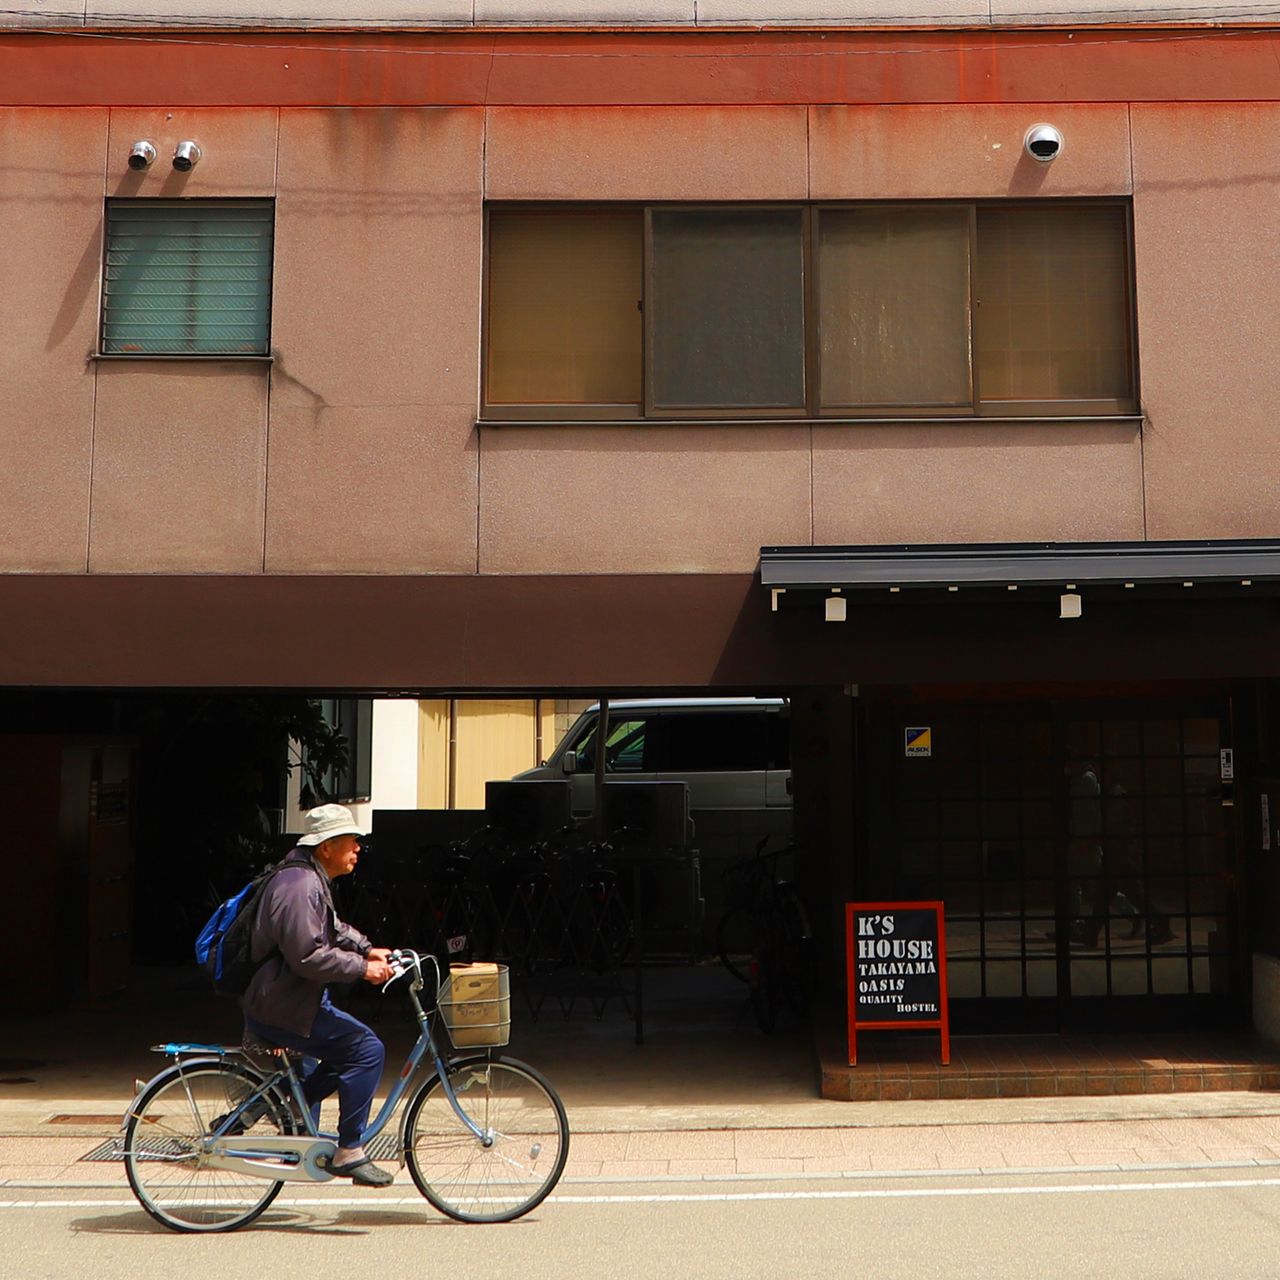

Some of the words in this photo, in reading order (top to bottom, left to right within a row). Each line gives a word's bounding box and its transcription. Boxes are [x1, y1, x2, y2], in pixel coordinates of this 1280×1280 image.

[858, 915, 895, 936] K'S
[858, 939, 933, 959] HOUSE
[858, 961, 936, 976] TAKAYAMA
[859, 979, 905, 993] OASIS
[859, 995, 904, 1004] QUALITY
[897, 1003, 937, 1013] HOSTEL
